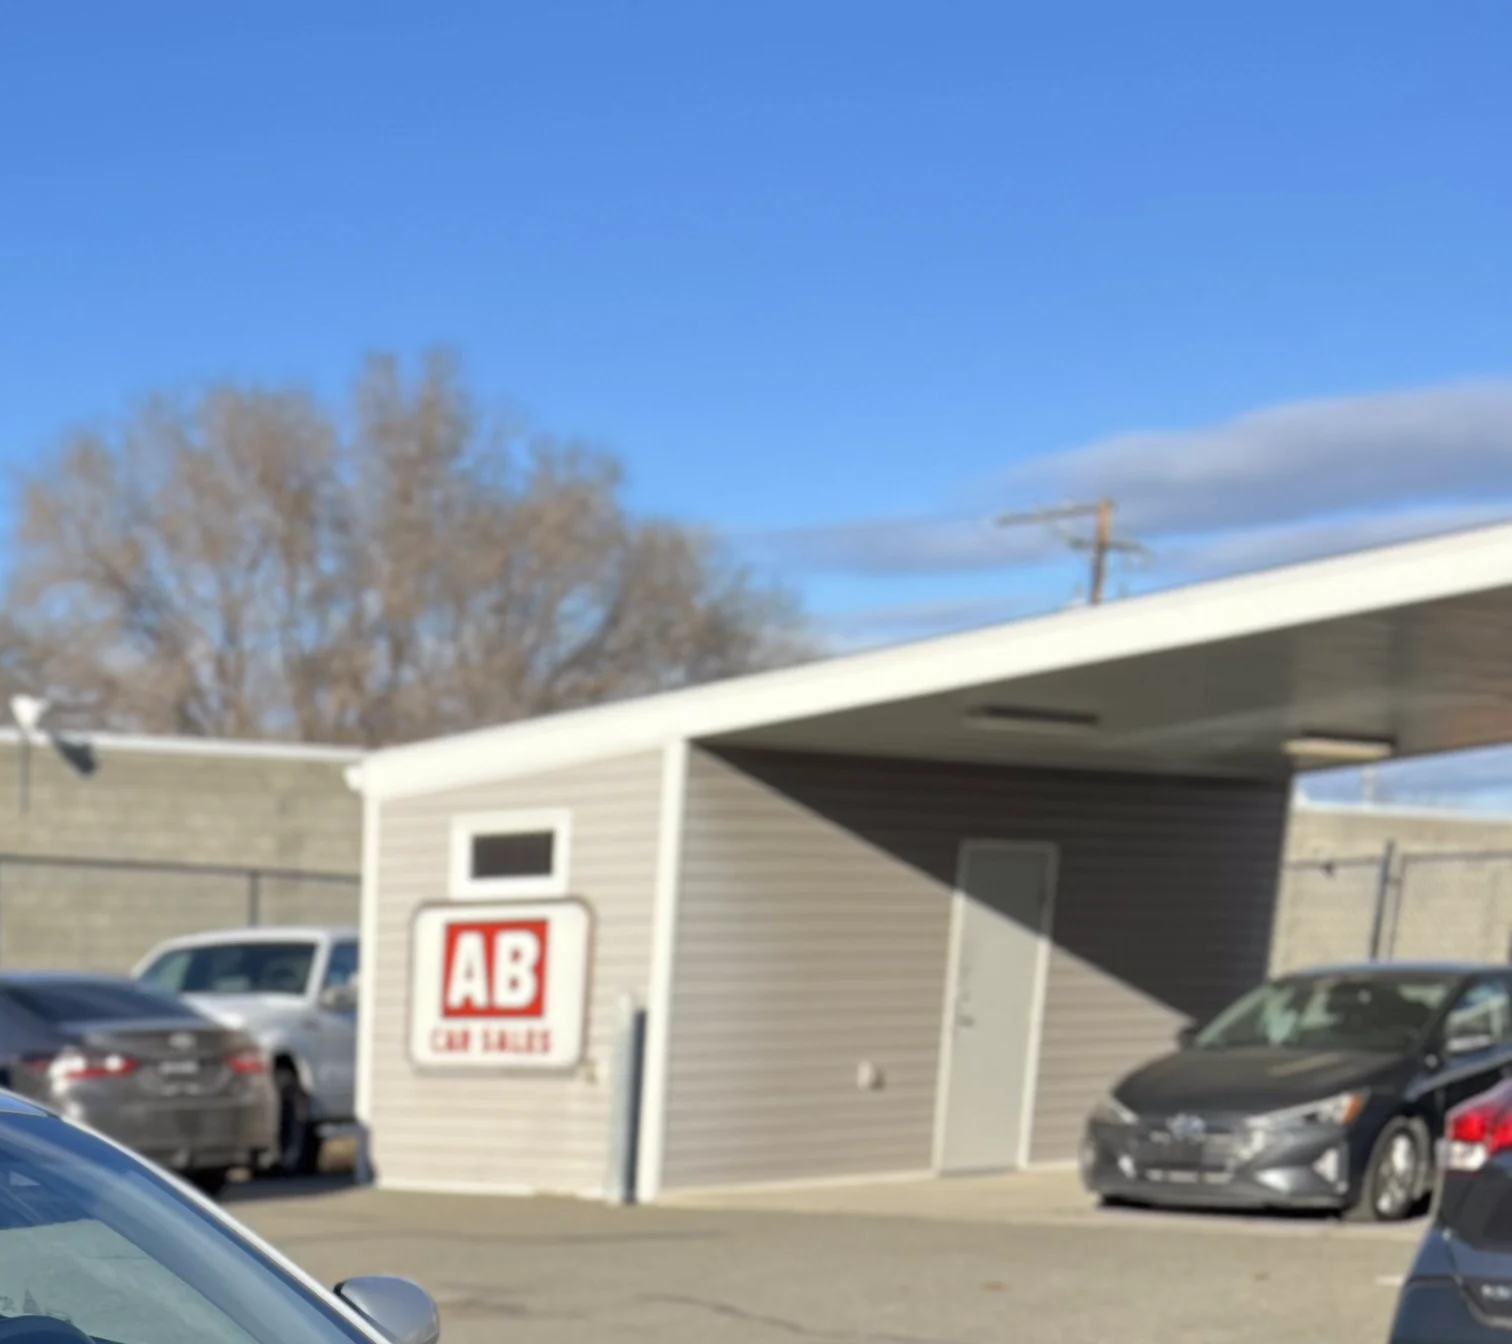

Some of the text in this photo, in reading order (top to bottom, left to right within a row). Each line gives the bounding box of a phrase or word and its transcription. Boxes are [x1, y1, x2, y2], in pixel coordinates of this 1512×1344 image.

[447, 930, 541, 1010] AB
[430, 1028, 551, 1054] CAR SALES
